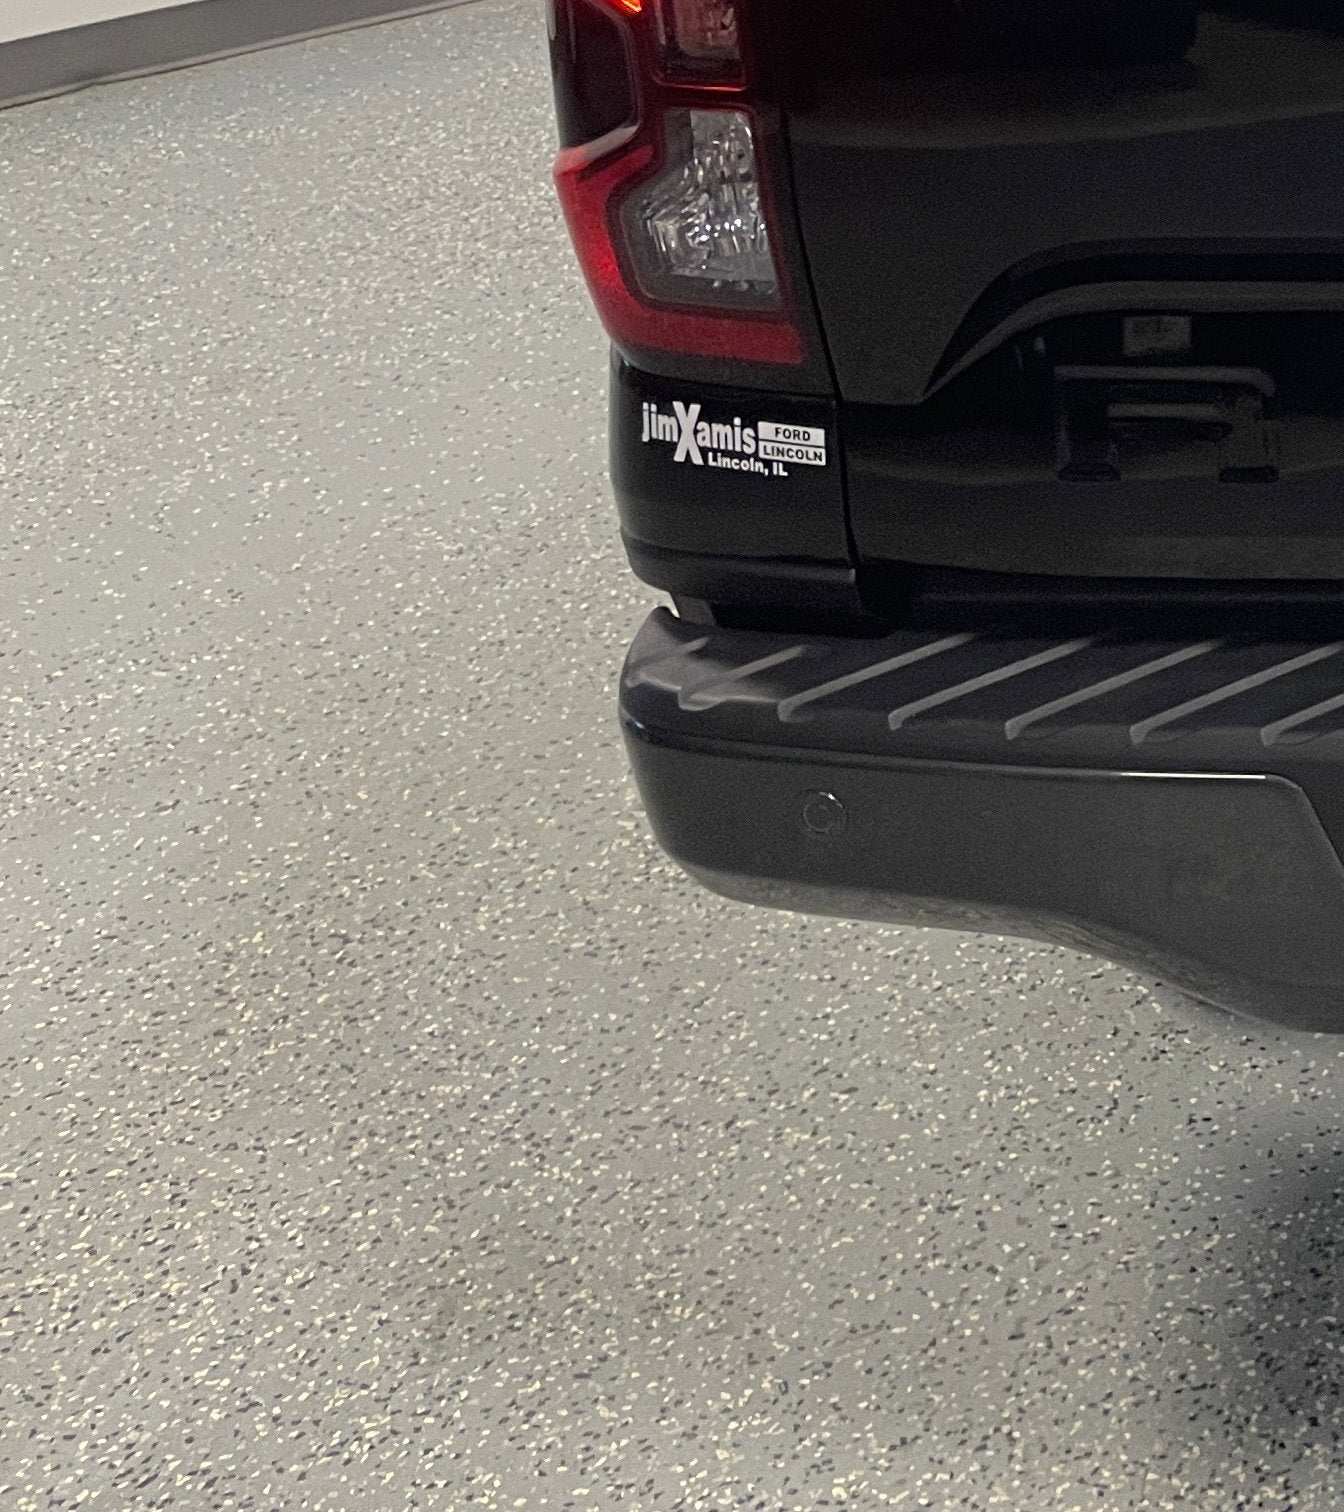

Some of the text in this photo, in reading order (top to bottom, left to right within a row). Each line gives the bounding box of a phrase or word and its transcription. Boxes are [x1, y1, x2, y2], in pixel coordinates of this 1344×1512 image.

[774, 426, 812, 443] FORD
[763, 443, 824, 463] LINCOLN
[707, 451, 788, 477] Lincoln, IL
